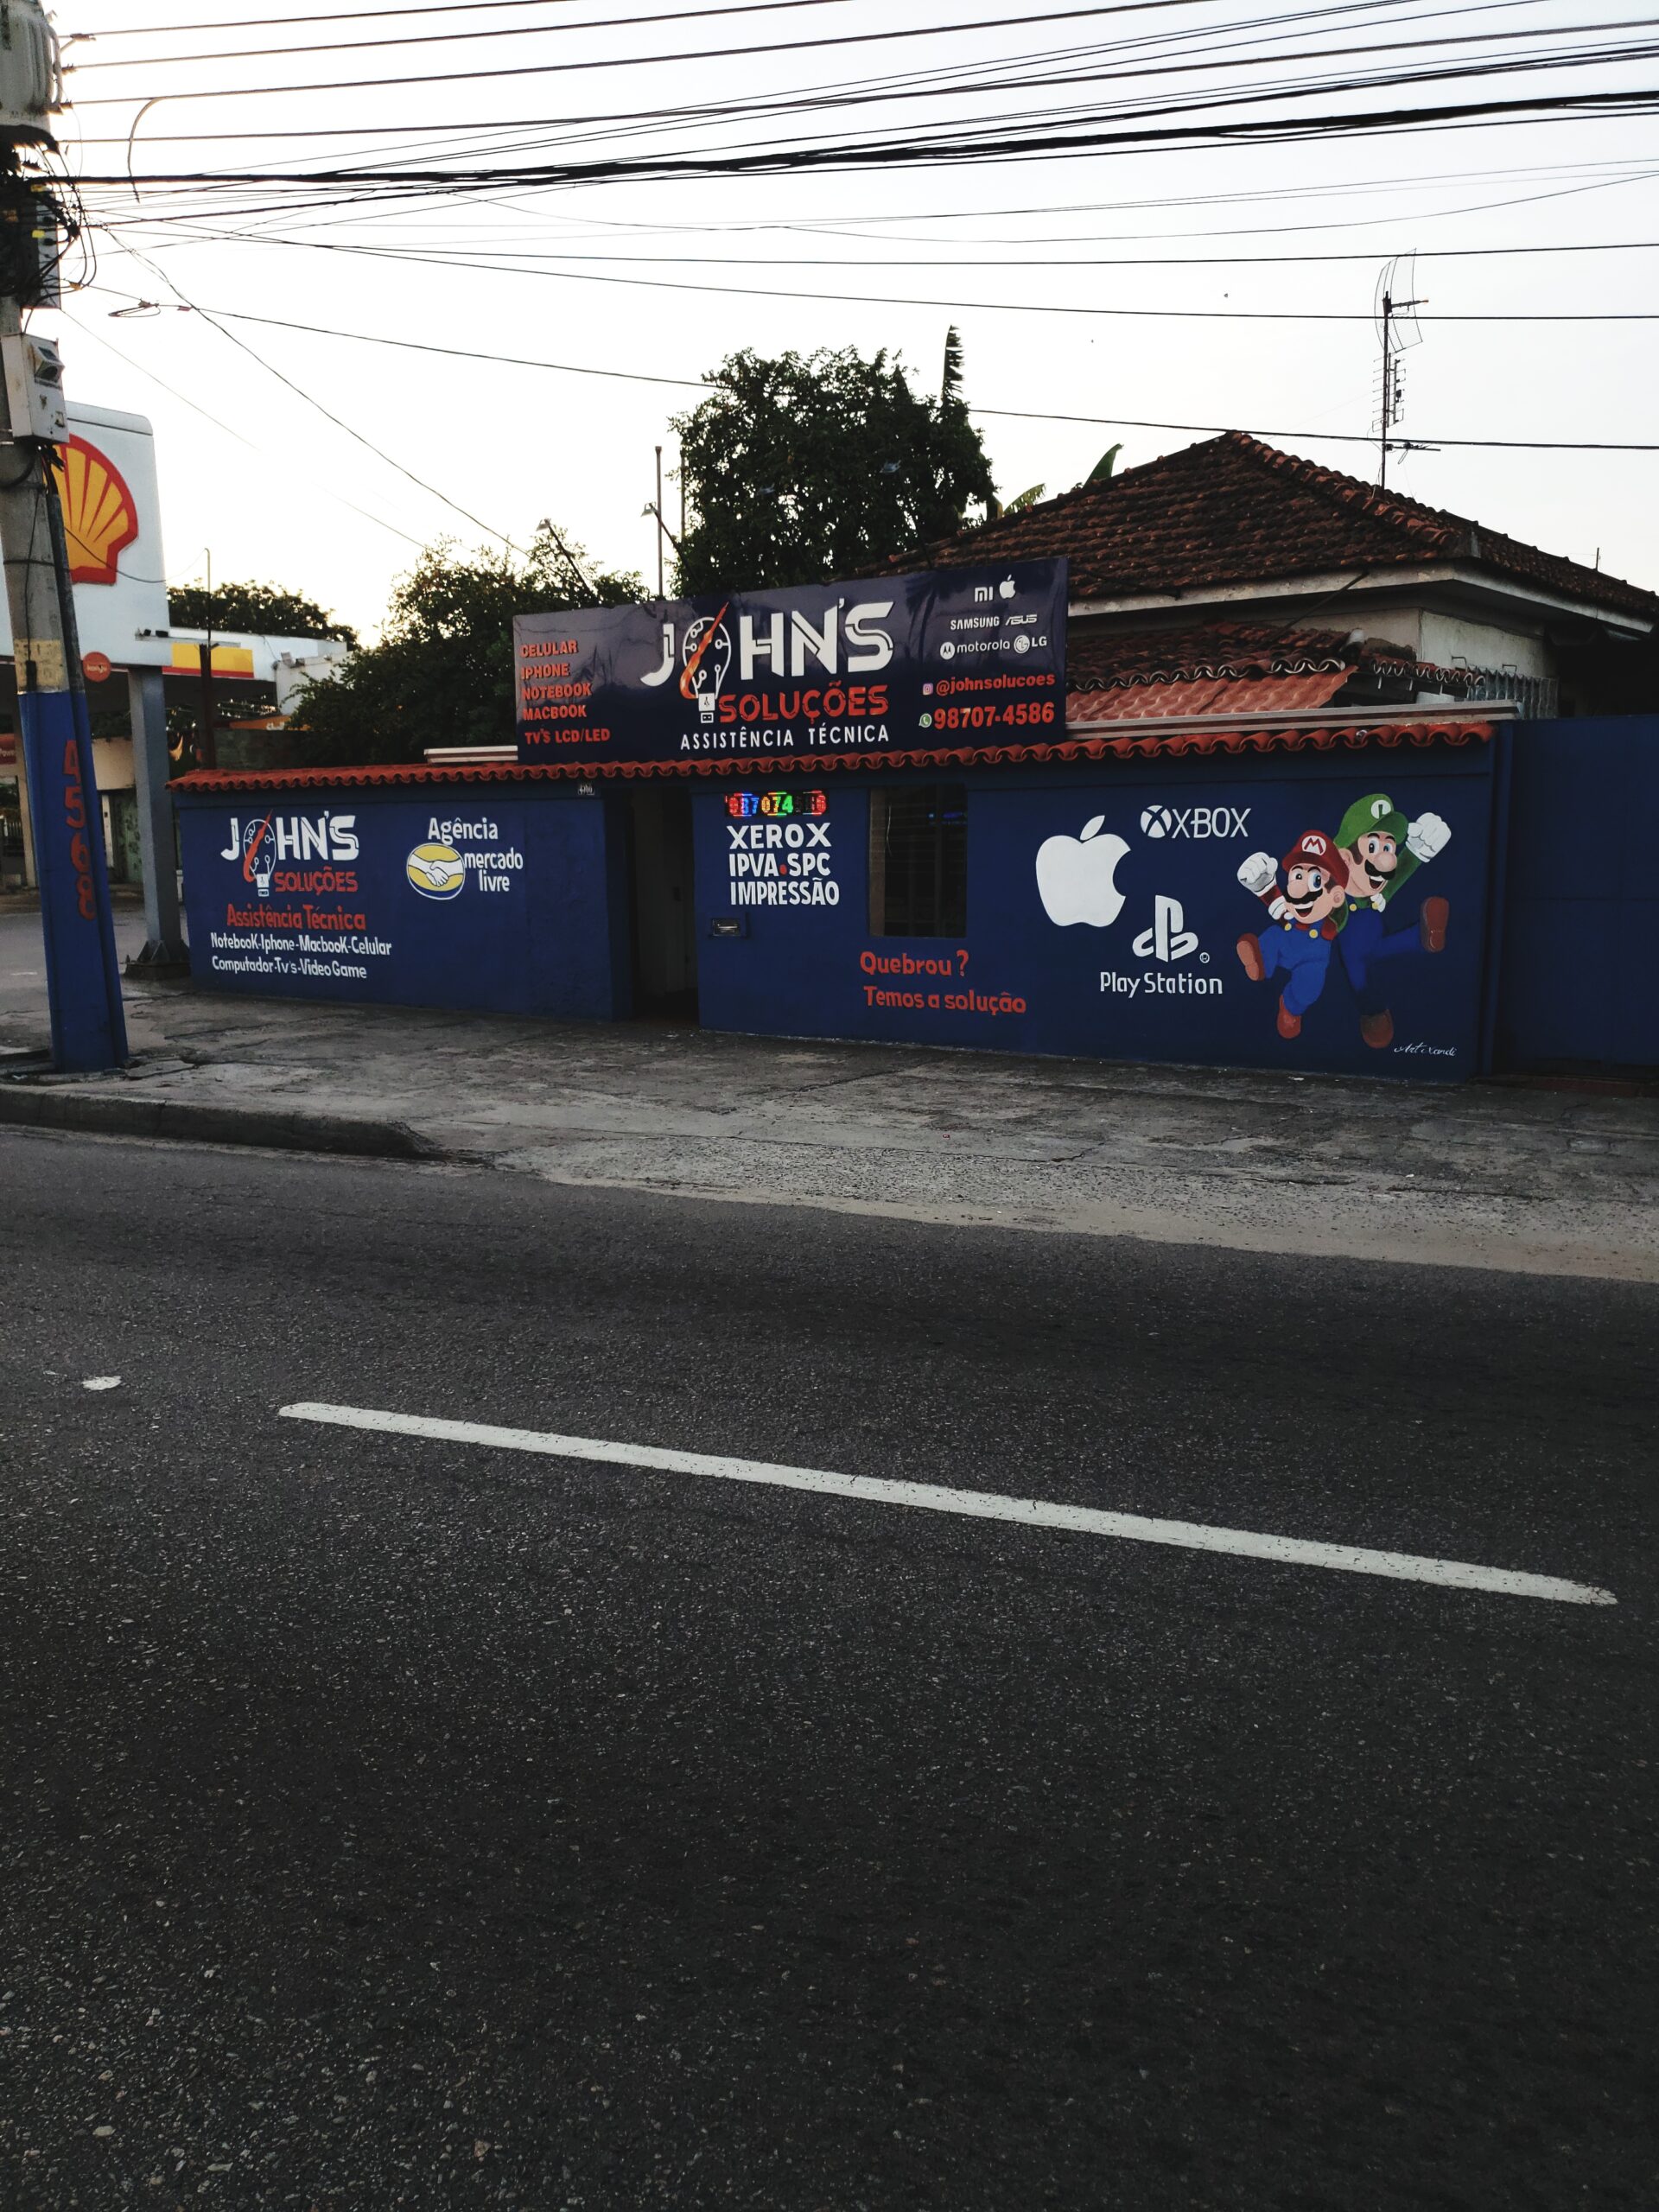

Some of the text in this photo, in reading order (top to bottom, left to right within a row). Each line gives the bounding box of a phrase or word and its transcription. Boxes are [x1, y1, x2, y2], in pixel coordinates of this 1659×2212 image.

[950, 613, 1038, 630] SAMSUNG ASUS
[519, 639, 579, 658] CELULAR
[957, 636, 1048, 653] motorola LG
[520, 663, 570, 680] IPHONE
[521, 682, 593, 701] NOTEBOOK
[936, 673, 1056, 696] @johnsolucoes
[522, 704, 588, 721] MACBOOK
[718, 680, 889, 725] SOLUÇÕES
[524, 728, 611, 745] TV'S LCD/LED
[680, 722, 890, 750] ASSISTÊNCIA TÉCNICA
[428, 817, 499, 846] Agência
[727, 822, 832, 849] XEROX
[464, 847, 524, 870] mercado
[274, 865, 359, 897] SOLUÇÕES
[479, 869, 510, 892] livre
[730, 877, 840, 906] IMPRESSÃO
[226, 903, 366, 931] Assistência Técnica
[331, 960, 368, 979] Game
[860, 950, 951, 976] Quebrou
[864, 985, 1027, 1016] Temos a solução
